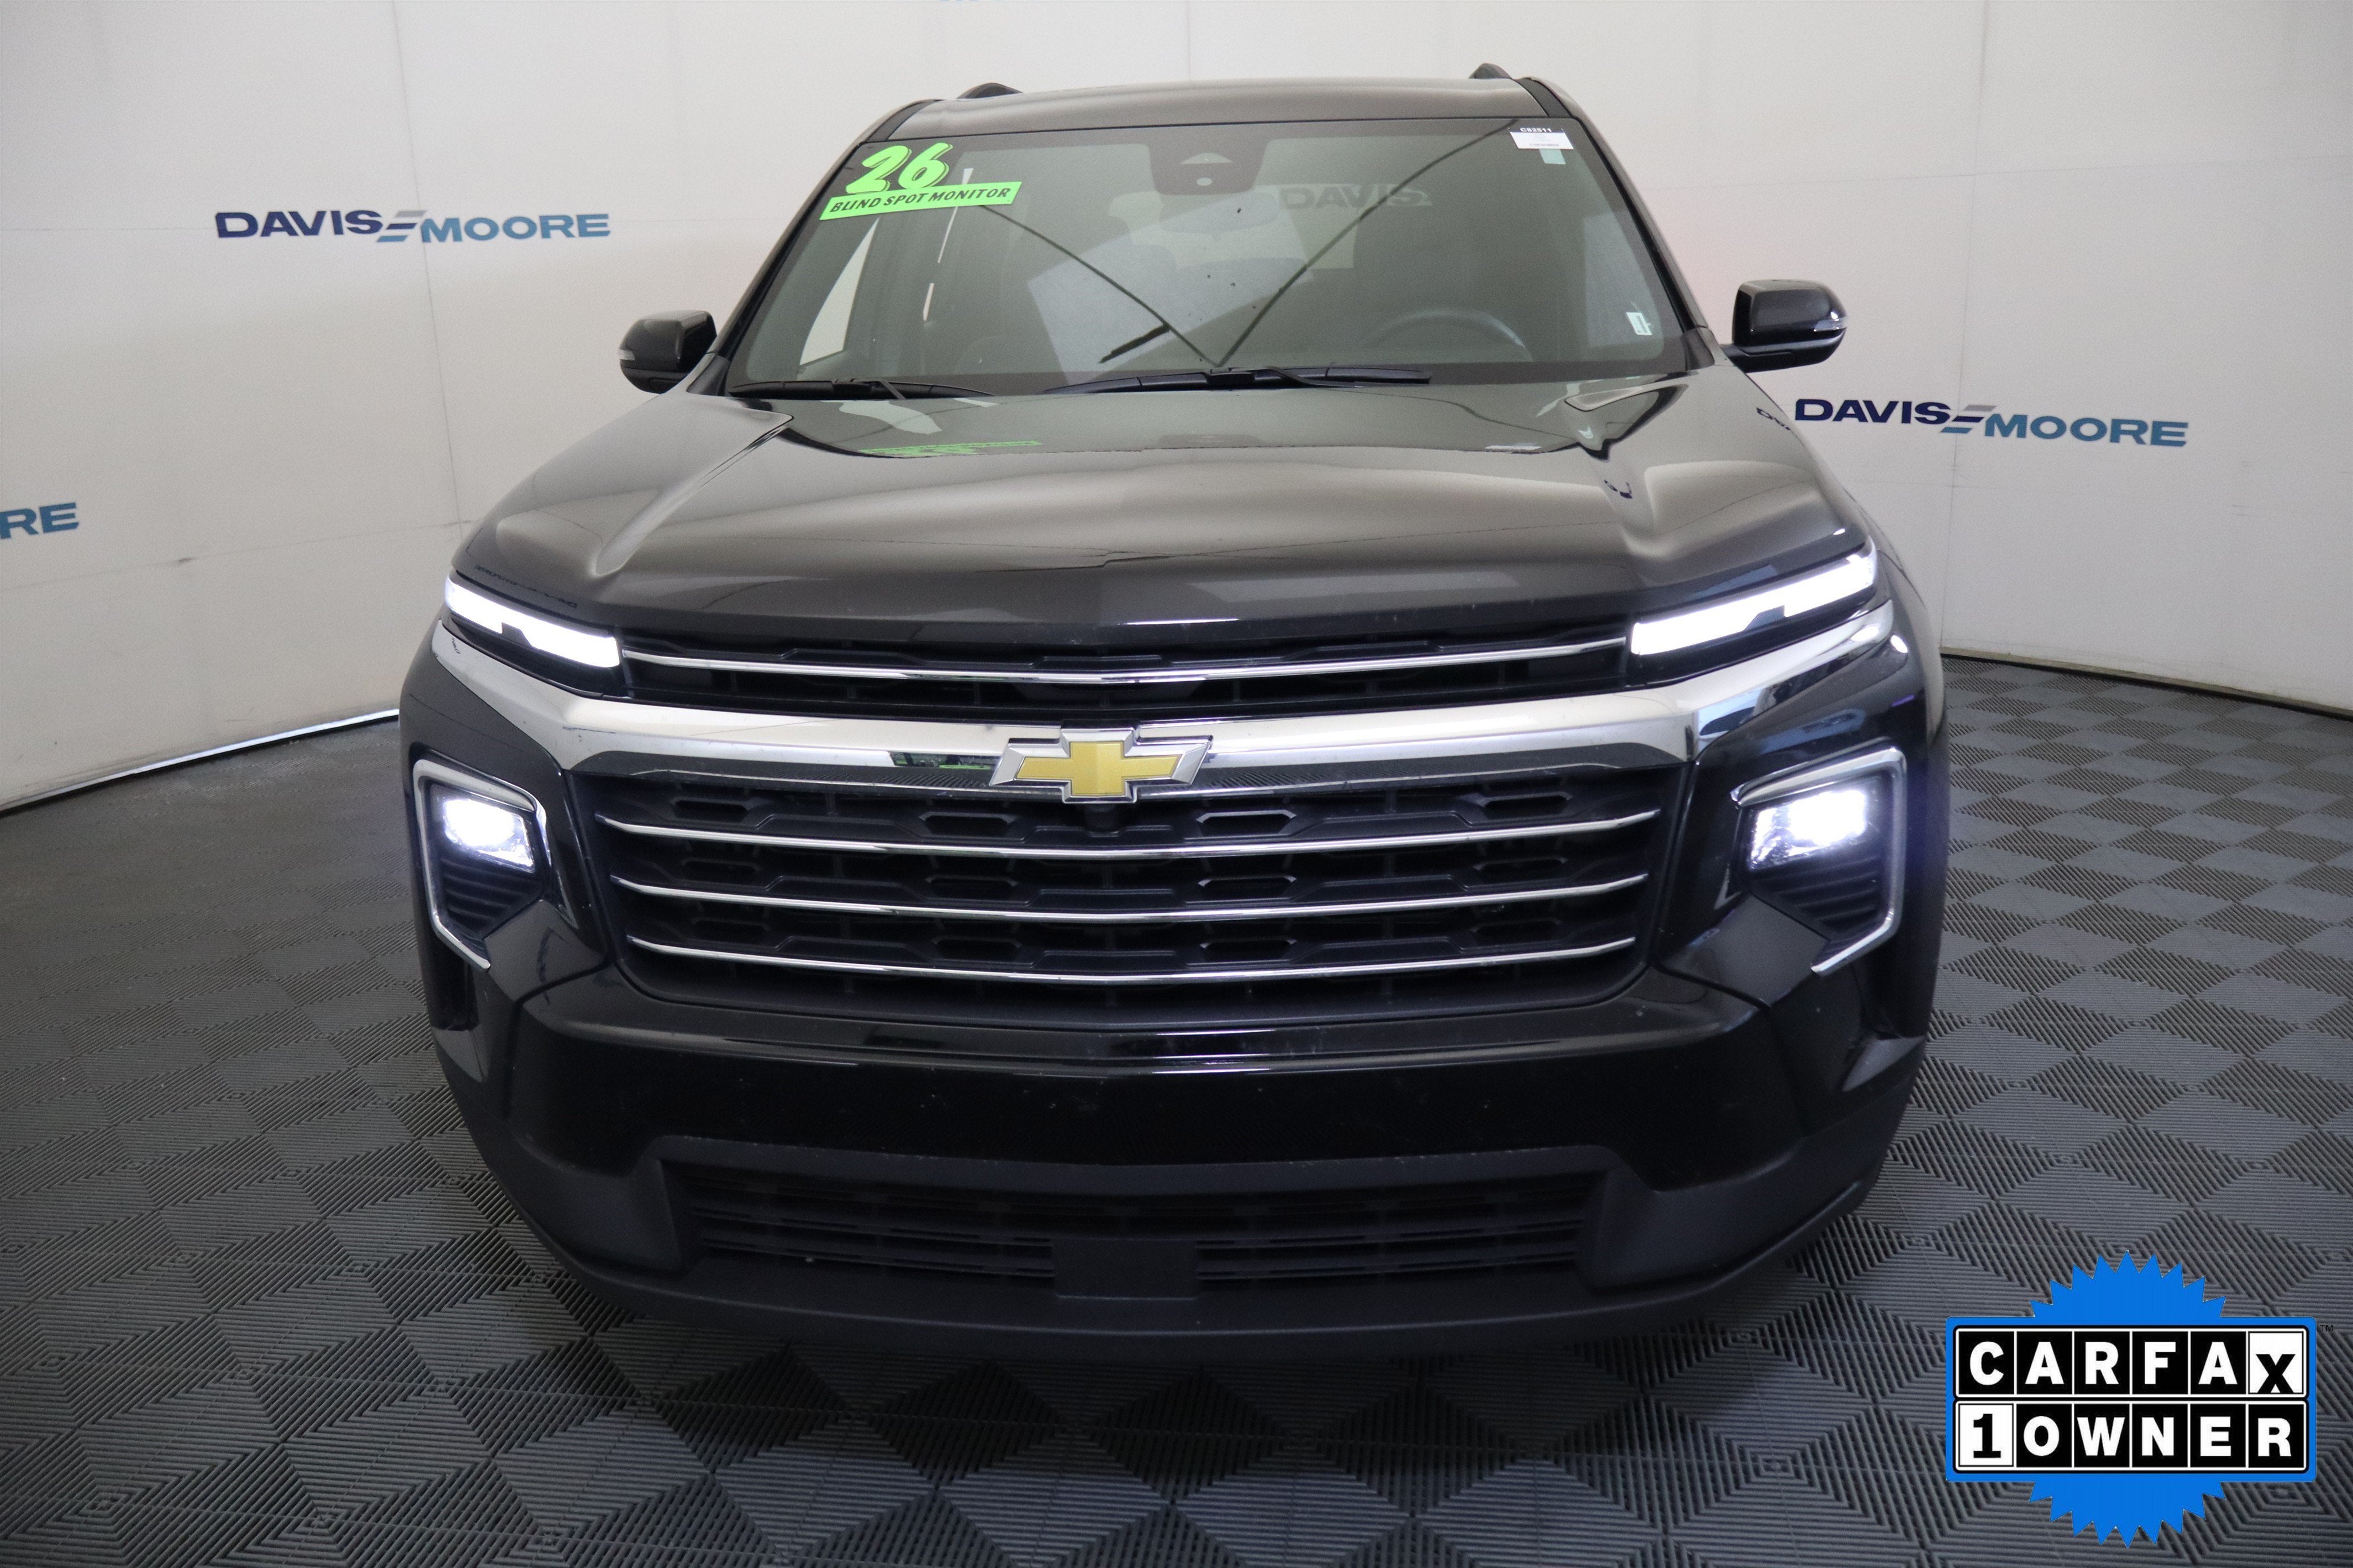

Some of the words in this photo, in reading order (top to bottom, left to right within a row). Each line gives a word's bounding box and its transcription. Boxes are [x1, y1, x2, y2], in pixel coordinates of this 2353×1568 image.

[846, 142, 953, 194] 26
[830, 198, 882, 213] BLIND
[883, 193, 929, 206] SPOT
[928, 188, 1011, 202] MONITOR
[215, 210, 382, 238] DAVIS
[421, 214, 611, 243] MOORE
[1795, 399, 1951, 425] DAVIS
[1984, 414, 2189, 447] MOORE
